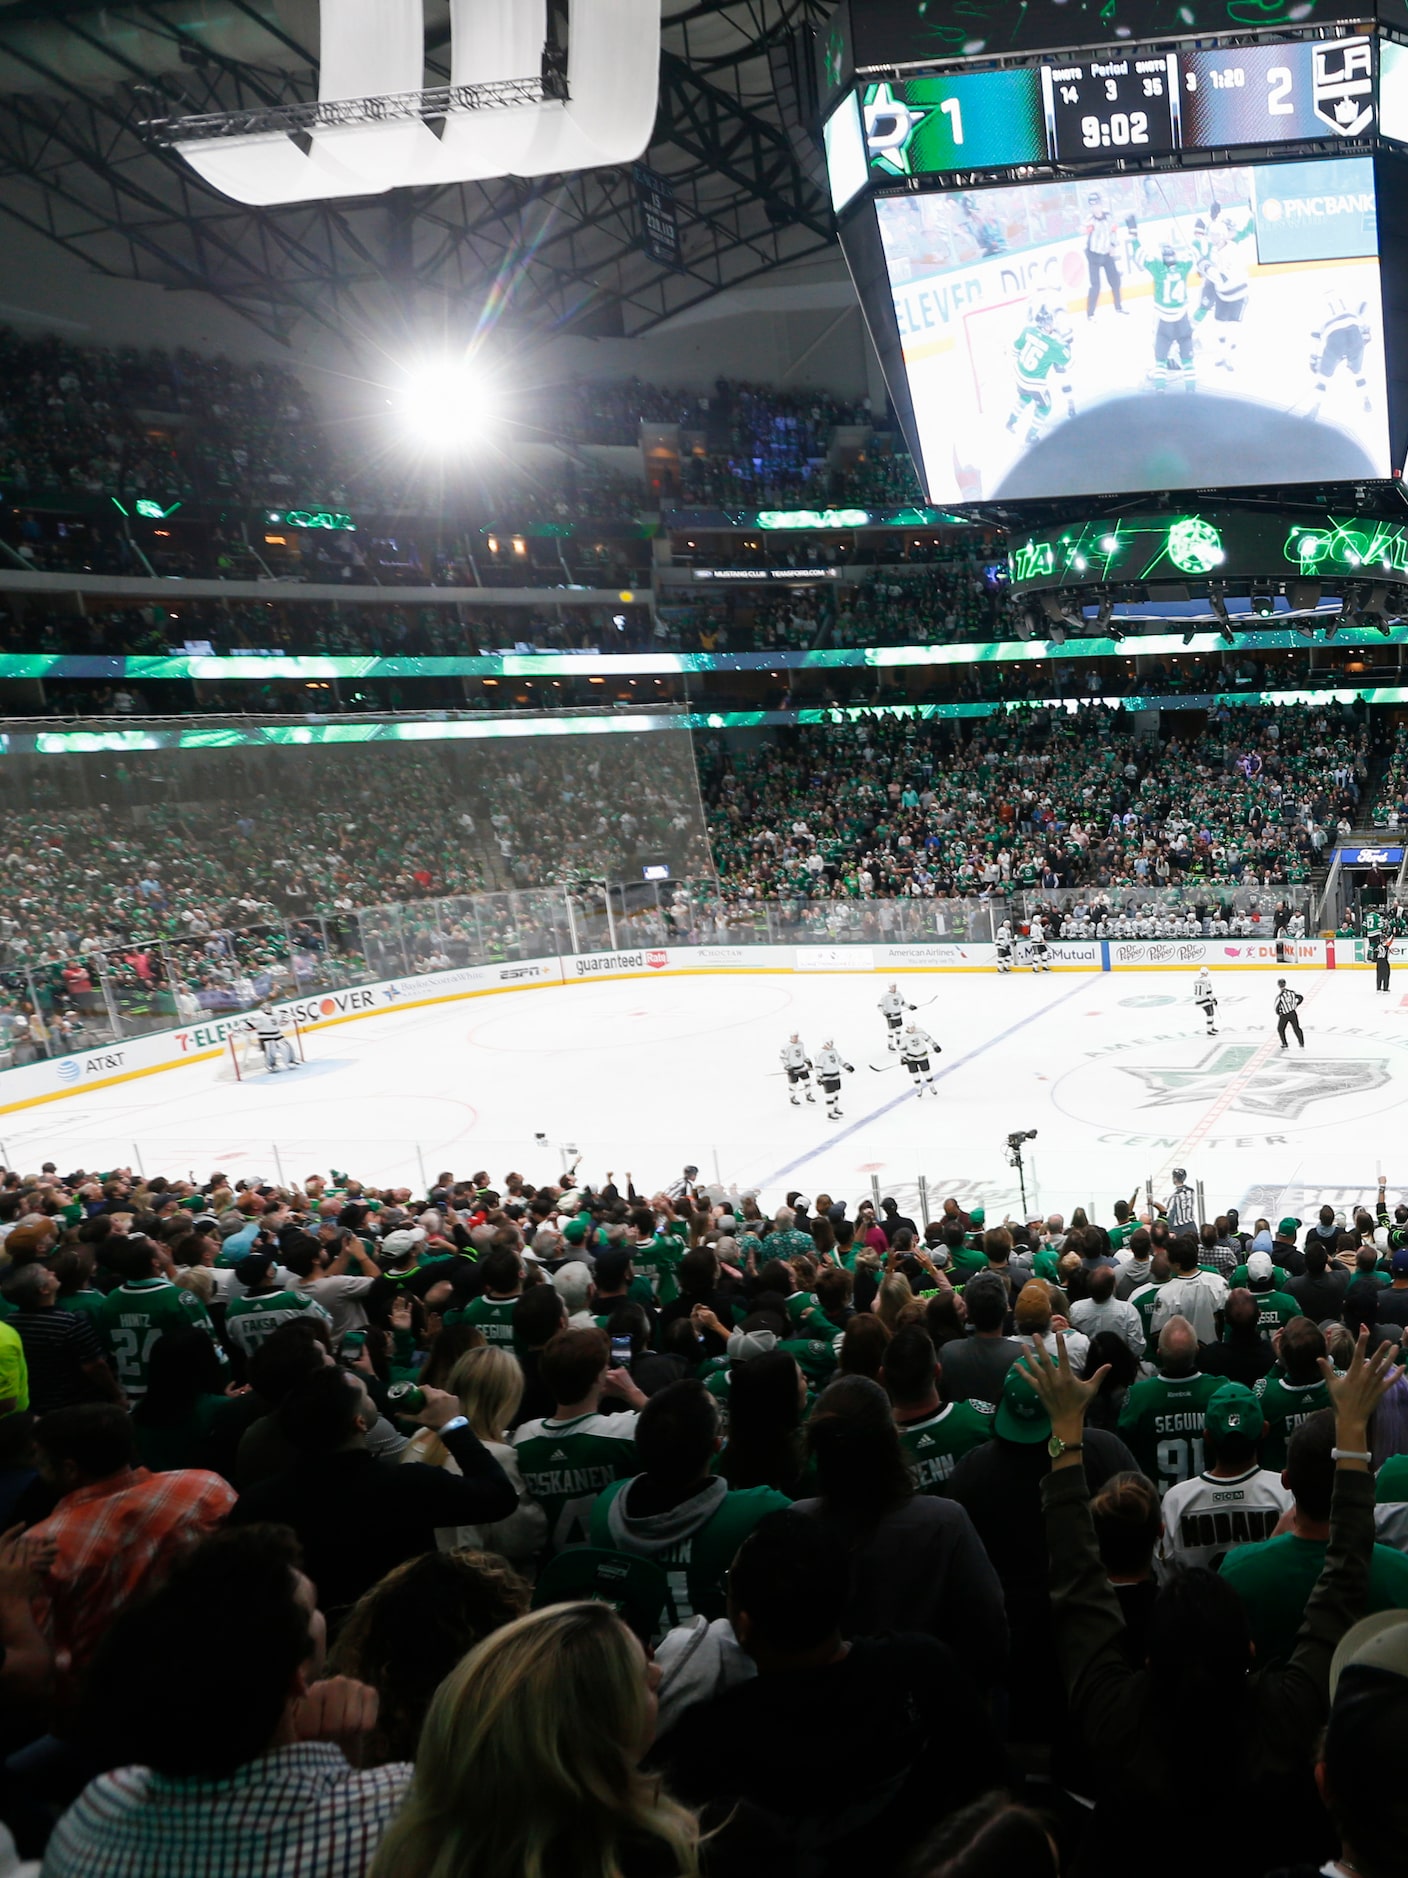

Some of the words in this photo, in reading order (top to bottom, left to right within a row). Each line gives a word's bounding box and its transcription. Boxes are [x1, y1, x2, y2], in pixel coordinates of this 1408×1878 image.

[1090, 60, 1129, 78] Period
[1315, 43, 1372, 86] LA
[1142, 77, 1163, 97] 35
[1185, 72, 1197, 92] 3
[1209, 67, 1246, 90] 1:20
[1059, 85, 1080, 105] 14
[1104, 79, 1118, 101] 3
[1266, 66, 1295, 116] 2
[939, 98, 964, 145] 1
[1081, 110, 1149, 149] 9:02
[1357, 849, 1388, 863] Ford
[889, 949, 923, 957] American
[925, 949, 955, 957] Airlines
[1025, 947, 1096, 960] MsMutual
[1119, 947, 1143, 962] Pepper
[1126, 944, 1137, 953] Dr
[1149, 947, 1173, 962] Pepper
[1156, 944, 1167, 953] Dr
[1180, 947, 1203, 962] Pepper
[1186, 944, 1197, 953] Dr
[576, 952, 643, 976] guaranteed
[646, 950, 667, 963] Rate
[500, 966, 551, 980] ESPN+
[86, 1052, 125, 1075] AT&T
[119, 1313, 150, 1328] HINTZ
[242, 1317, 278, 1333] FAKSA
[1154, 1412, 1206, 1434] SEGUIN
[1156, 1438, 1206, 1496] 91
[524, 1464, 616, 1496] EISKANEN
[1213, 1491, 1244, 1501] CCM
[551, 1492, 600, 1552] 4
